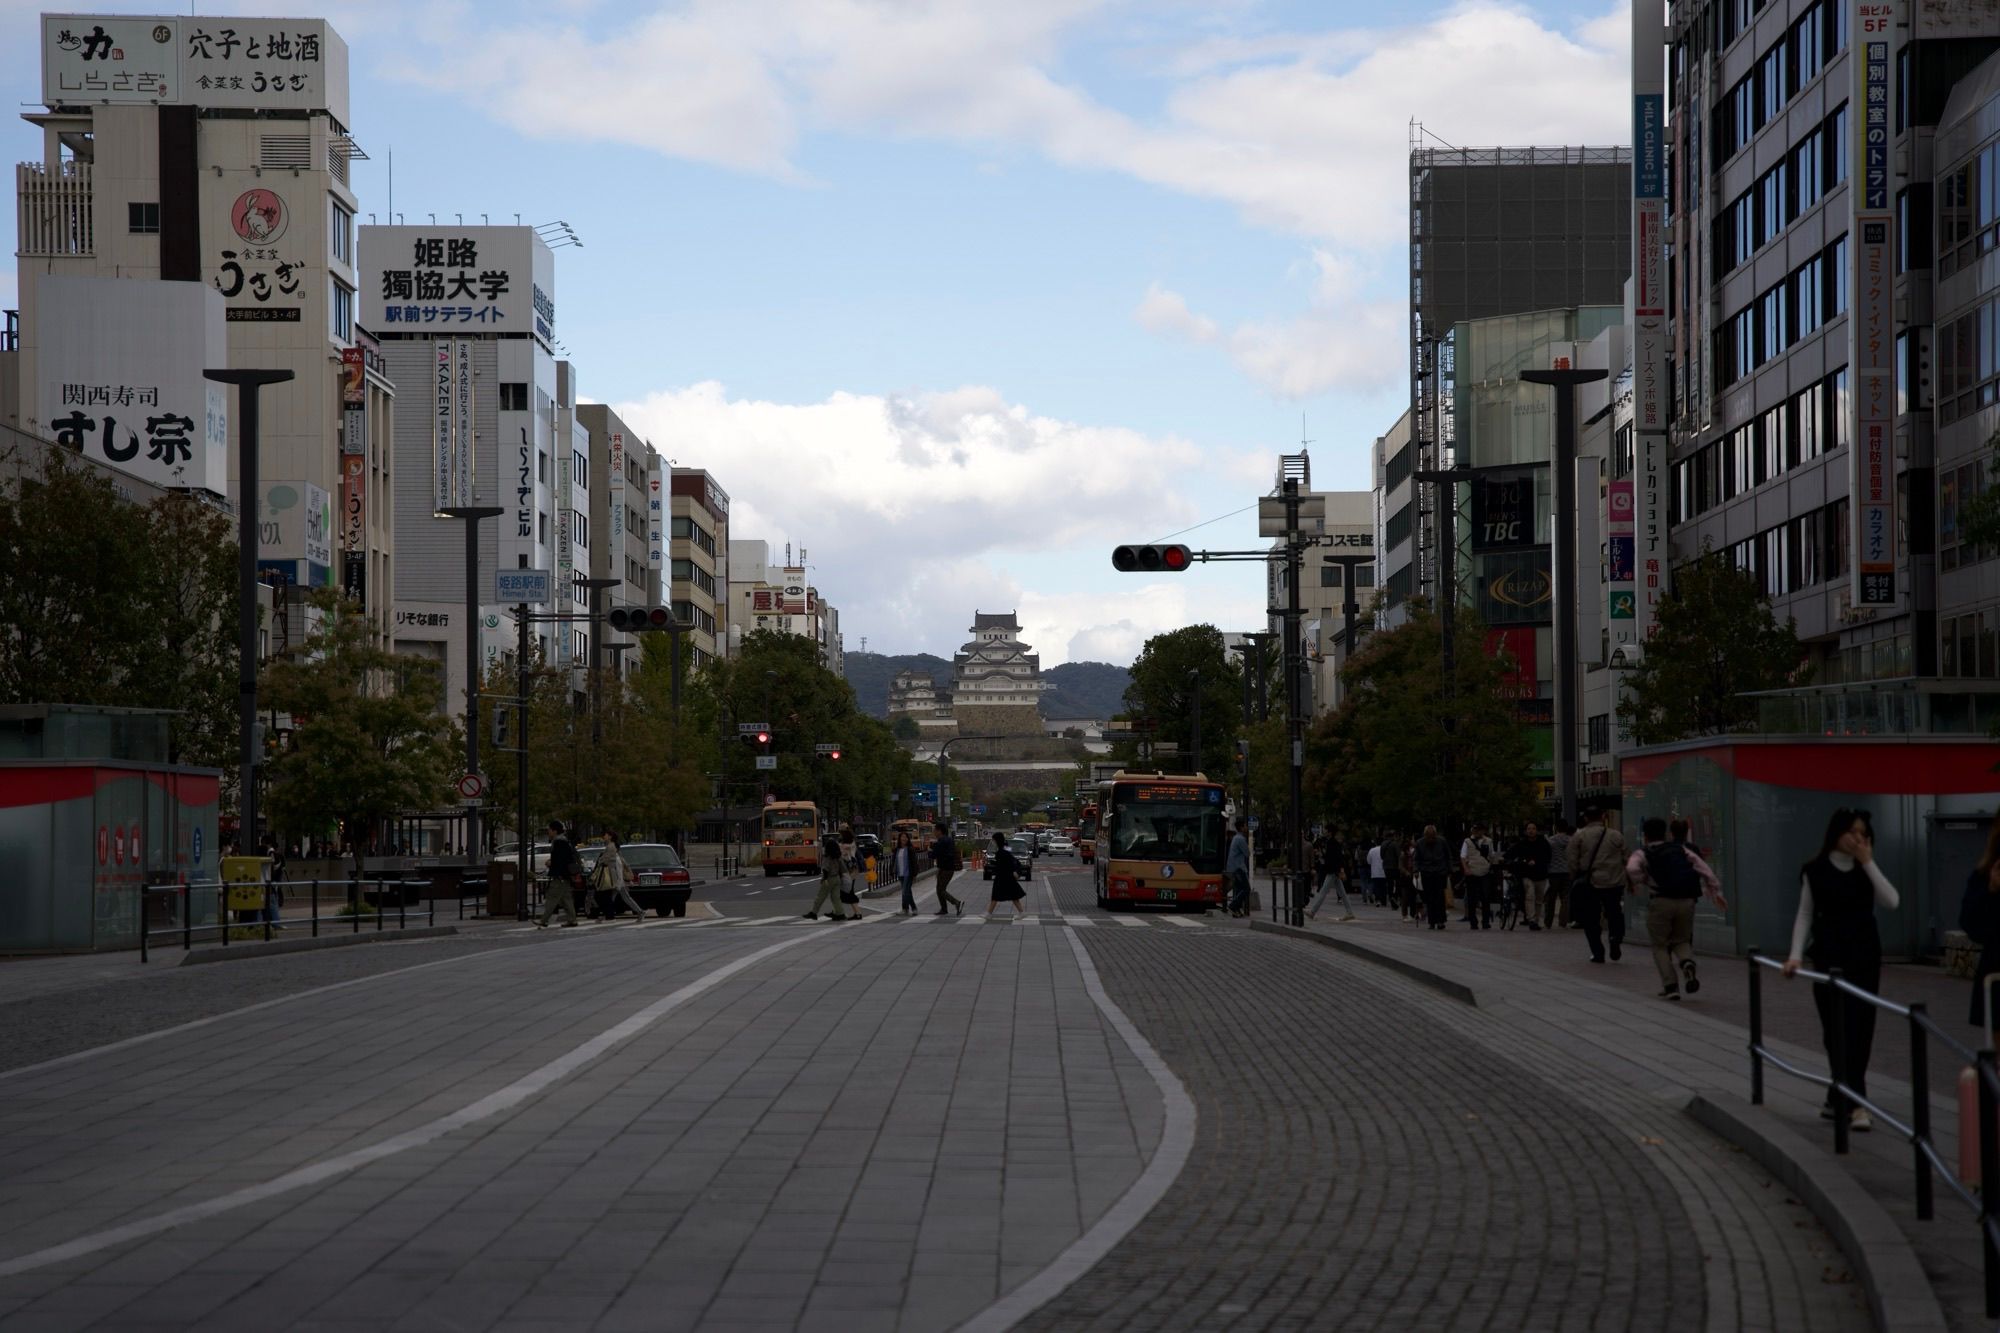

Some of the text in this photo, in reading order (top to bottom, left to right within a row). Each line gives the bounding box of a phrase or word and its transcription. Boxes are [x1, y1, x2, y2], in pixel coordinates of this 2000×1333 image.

[1859, 5, 1891, 17] 当ビル
[1864, 19, 1888, 33] 5F
[154, 28, 169, 41] 6F
[189, 28, 320, 62] 穴子と地酒
[60, 69, 165, 92] しらさぎ
[196, 72, 308, 92] 食菜家 うさぎ
[1643, 101, 1654, 171] MILA CLINIC
[1868, 44, 1885, 207] 個別教室のトライ
[414, 238, 478, 268] 姫路
[1648, 212, 1659, 305] 湘南美容クリニック
[215, 250, 305, 301] うさぎ
[382, 270, 510, 301] 獨協大学
[385, 305, 505, 323] 駅前サテライト
[438, 343, 449, 416] TAKAZEN
[62, 383, 159, 407] 関西寿司
[51, 410, 195, 465] すし宗
[613, 433, 622, 471] 共栄火災
[518, 426, 531, 537] しらさぎビル
[1646, 441, 1659, 552] トレカショップ
[650, 500, 660, 560] 第一生命
[1483, 521, 1521, 542] TBC
[1870, 508, 1883, 560] カラオケ
[499, 575, 545, 590] 姫路駅前
[1506, 580, 1547, 594] RIZAP
[1865, 576, 1890, 588] 受付
[1866, 588, 1888, 601] 3F
[397, 612, 449, 627] りそな銀行
